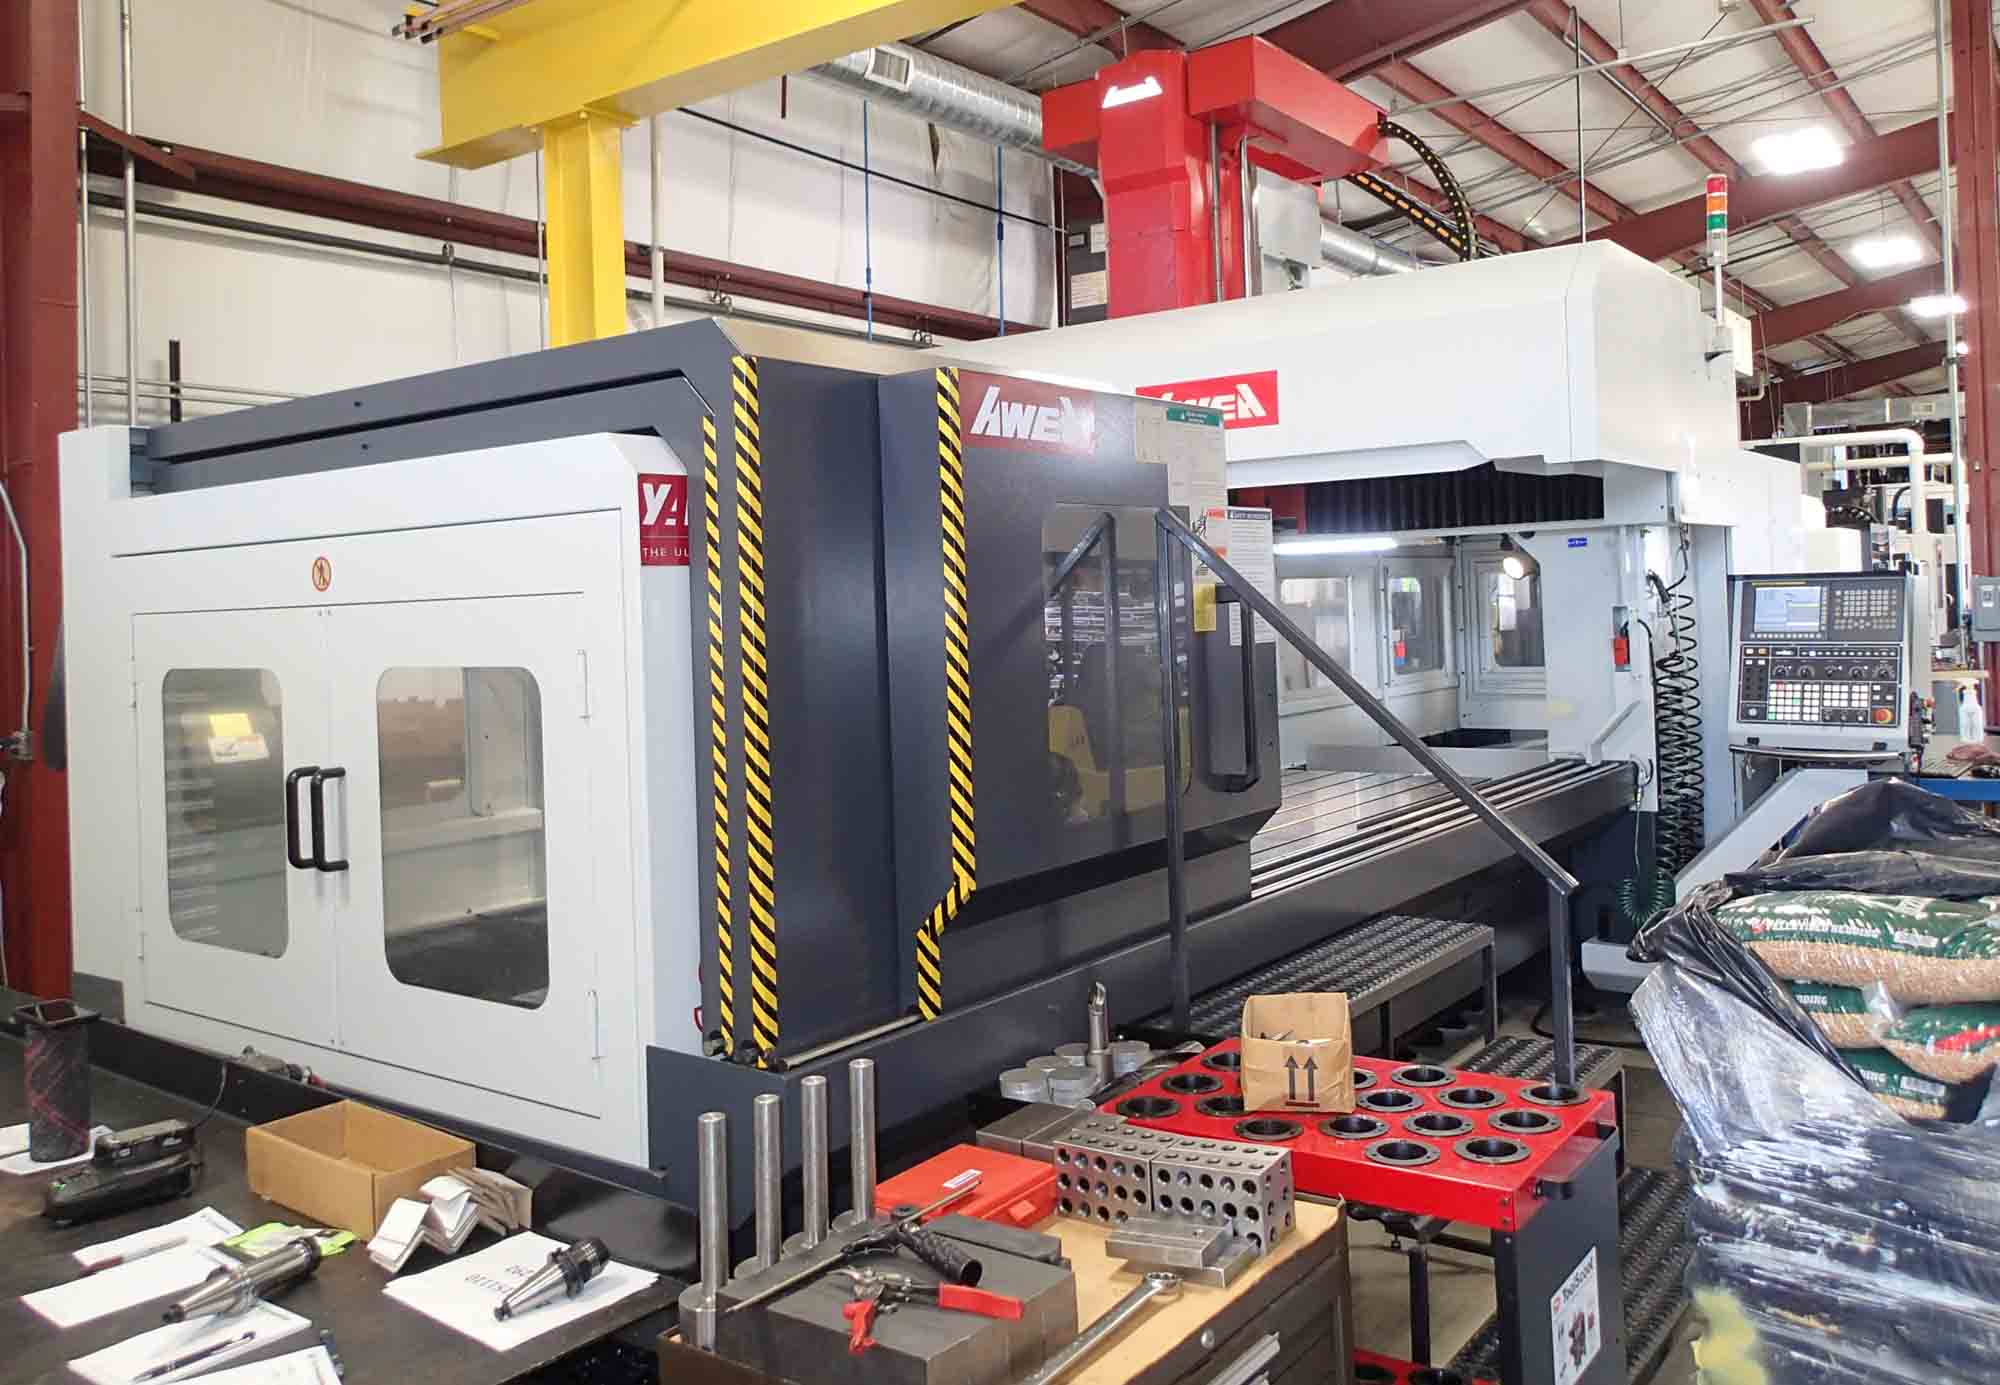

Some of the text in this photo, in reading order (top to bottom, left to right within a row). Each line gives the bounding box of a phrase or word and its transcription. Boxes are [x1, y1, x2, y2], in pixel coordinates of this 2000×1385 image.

[1160, 383, 1267, 421] EA
[642, 483, 688, 526] YA
[643, 547, 667, 558] THE
